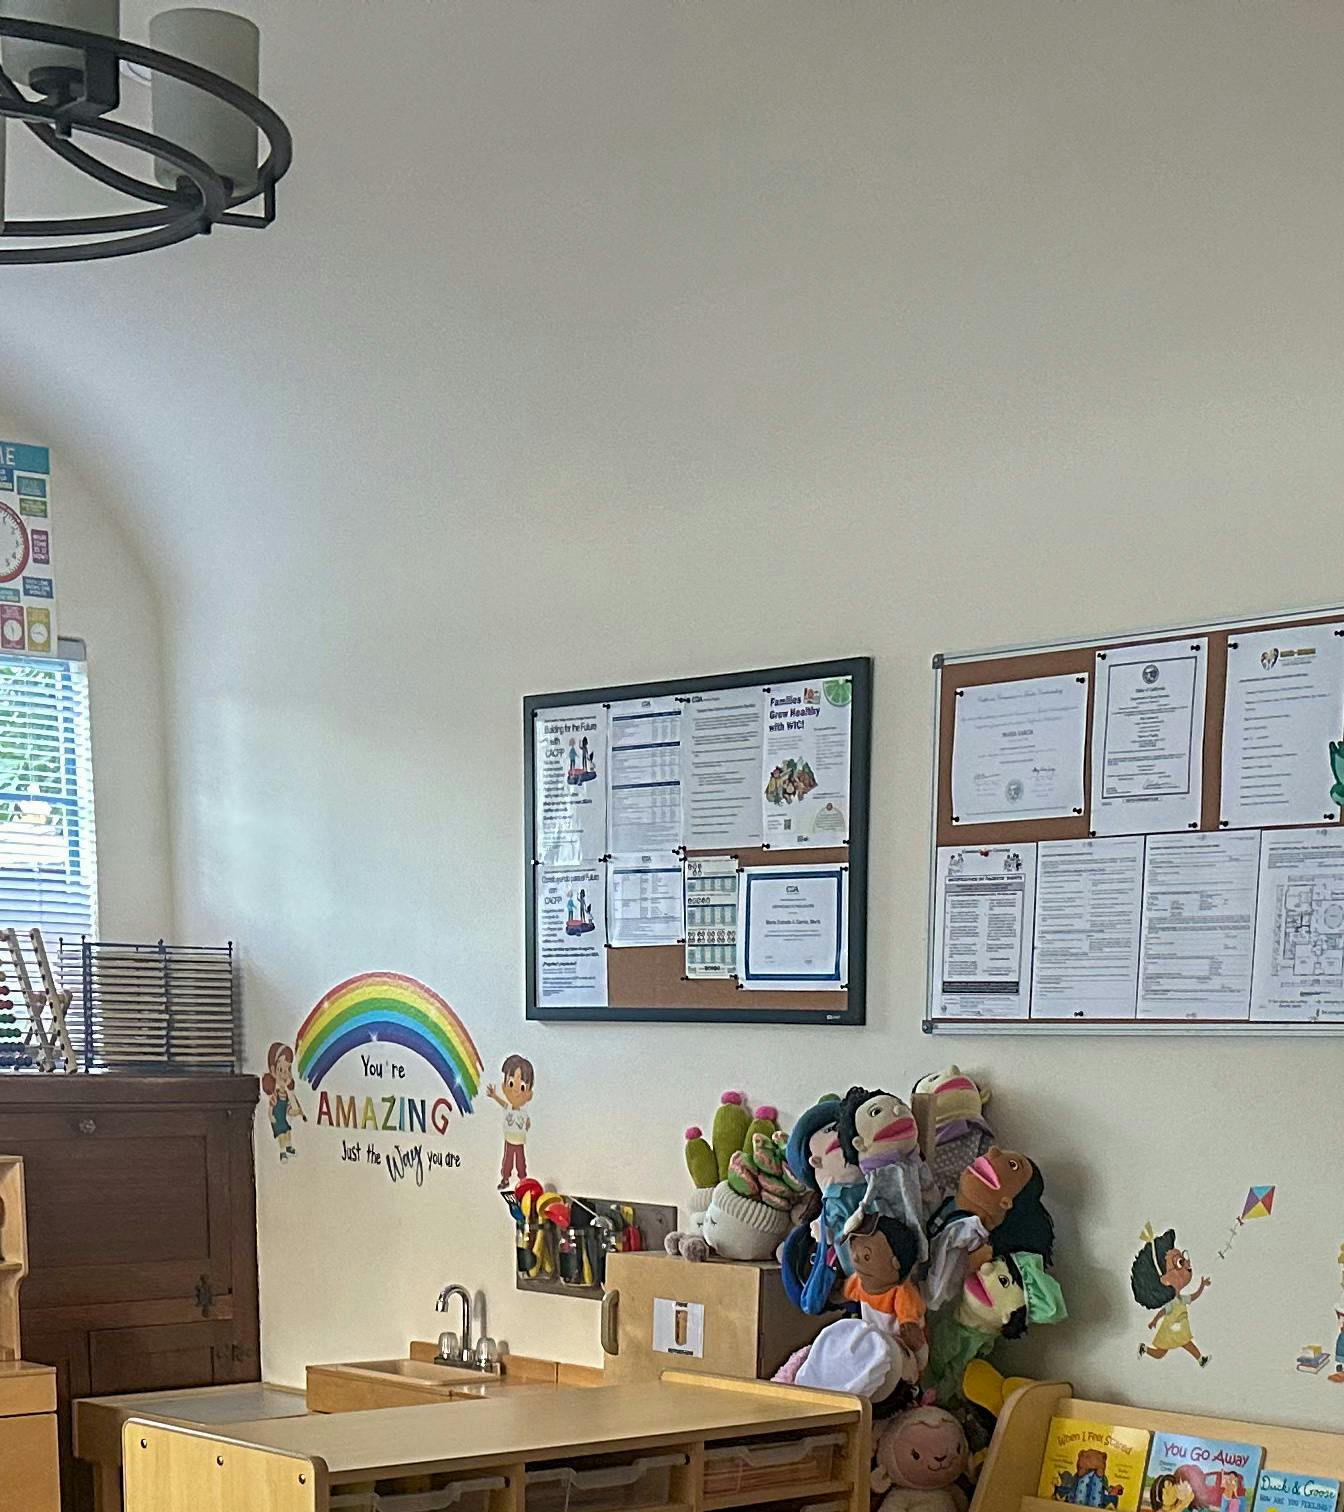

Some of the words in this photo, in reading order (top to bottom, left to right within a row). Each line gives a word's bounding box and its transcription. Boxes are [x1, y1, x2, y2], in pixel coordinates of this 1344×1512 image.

[769, 709, 788, 720] Grow
[790, 706, 820, 718] Healthy
[770, 695, 802, 707] Families
[769, 721, 785, 732] with
[317, 1091, 453, 1136] AMAZING
[342, 1140, 361, 1162] Just
[367, 1143, 382, 1165] the
[386, 1144, 424, 1187] Way
[427, 1151, 443, 1171] you
[445, 1151, 461, 1167] are
[1057, 1432, 1081, 1448] When
[1082, 1432, 1087, 1442] I
[1088, 1431, 1104, 1444] Feel
[1103, 1435, 1134, 1455] Scared
[1163, 1441, 1186, 1458] You
[1190, 1446, 1210, 1462] Go
[1212, 1450, 1250, 1468] Away
[1260, 1475, 1289, 1493] Duck
[1291, 1480, 1301, 1494] &
[1302, 1479, 1336, 1500] Goose
